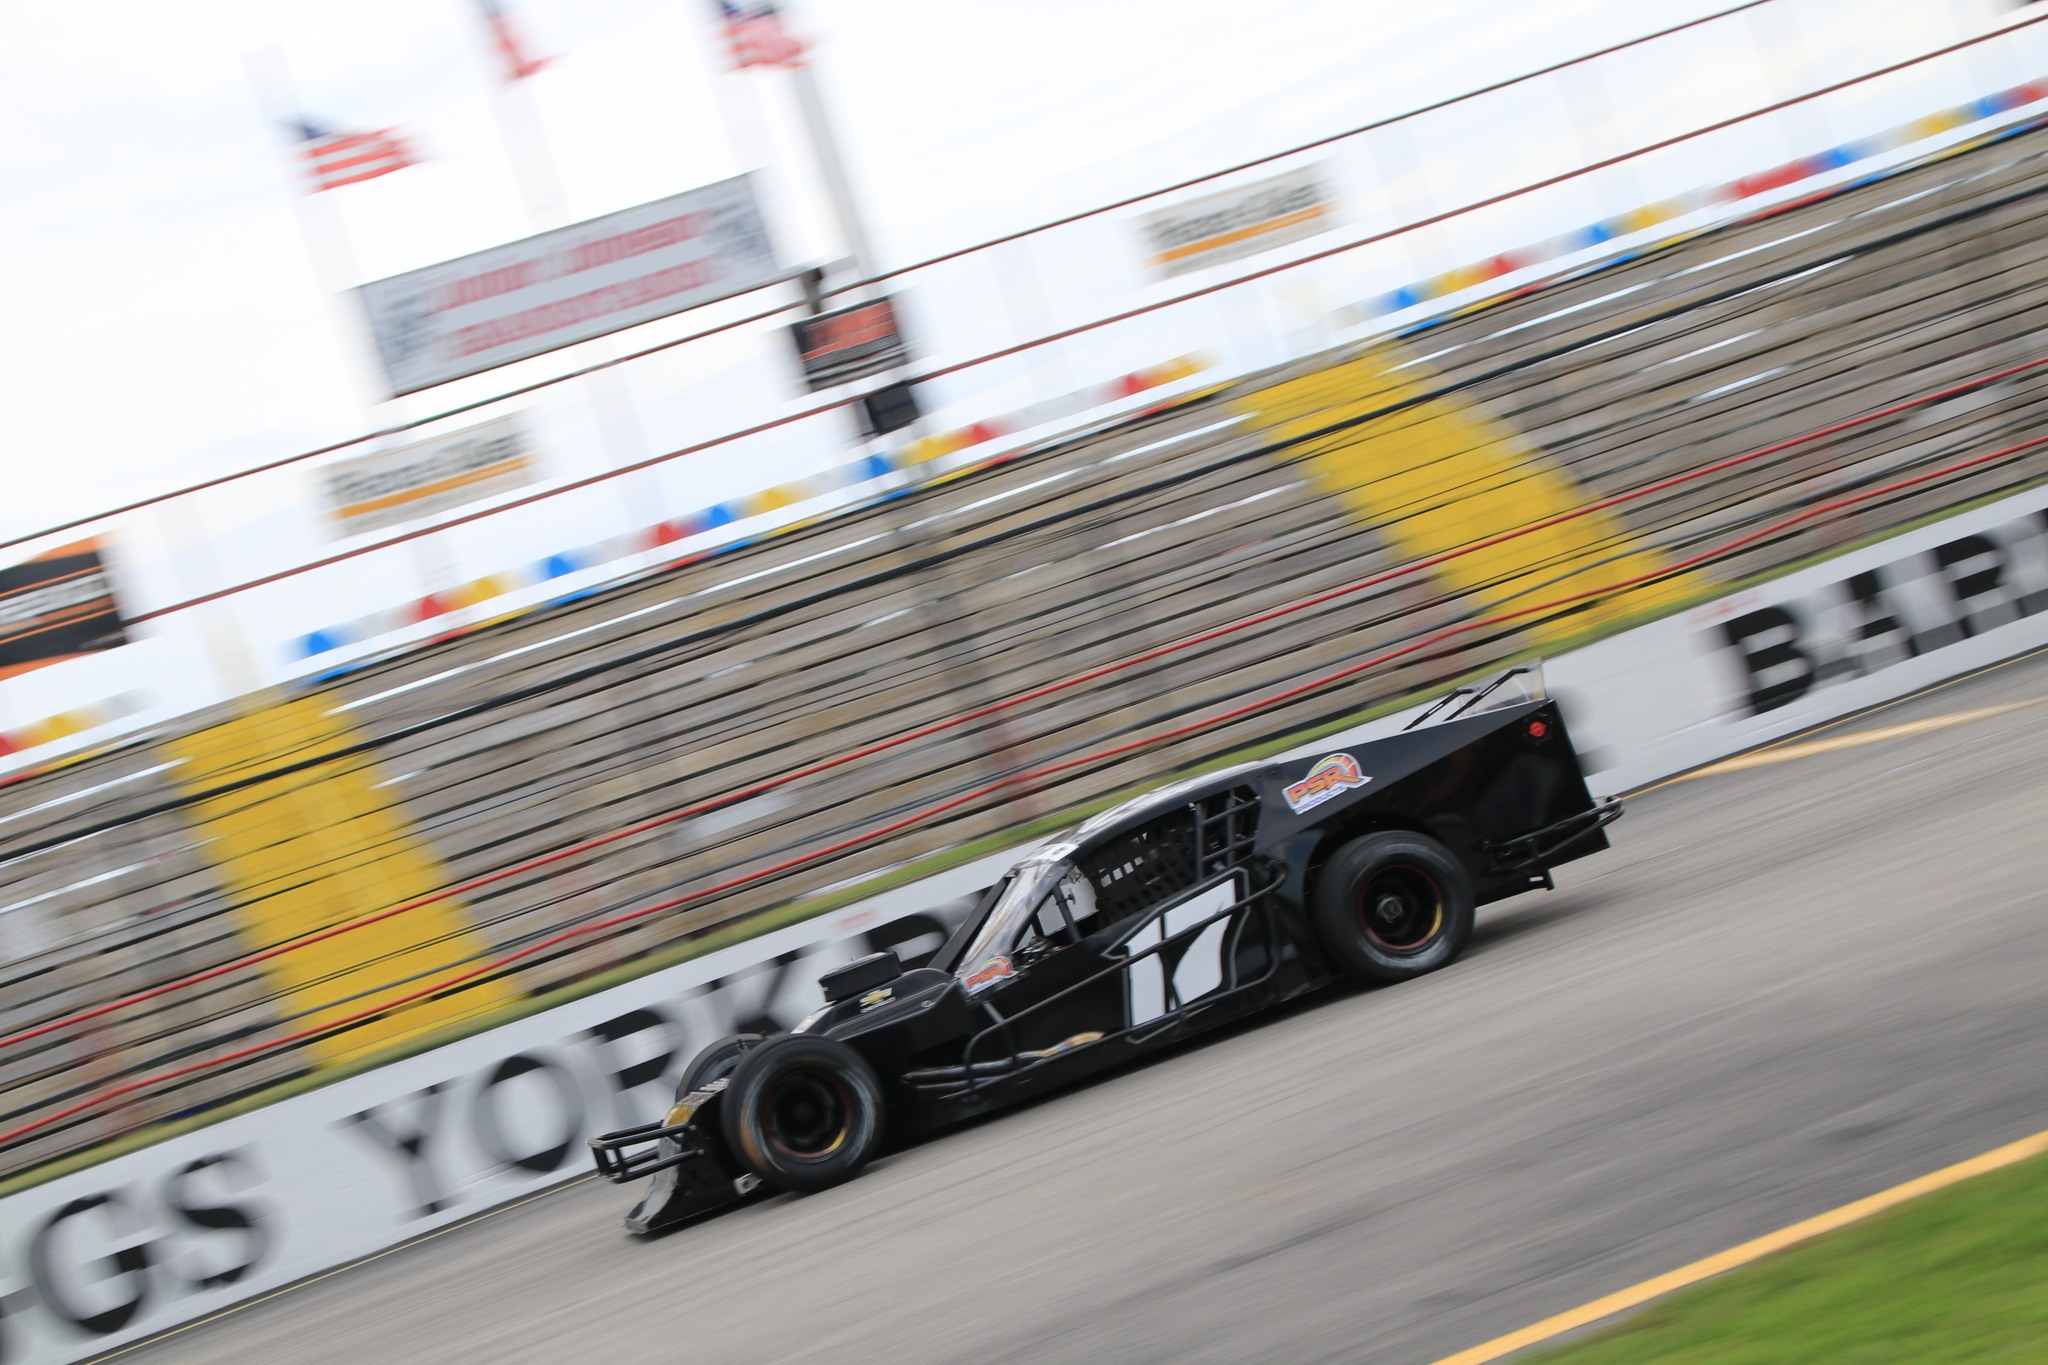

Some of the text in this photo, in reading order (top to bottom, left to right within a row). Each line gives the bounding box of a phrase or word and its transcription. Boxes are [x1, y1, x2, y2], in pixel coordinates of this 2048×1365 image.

[1696, 508, 2048, 724] BAR
[1286, 765, 1361, 804] PSR
[1124, 878, 1238, 1027] 17
[0, 940, 830, 1352] GS YORK
